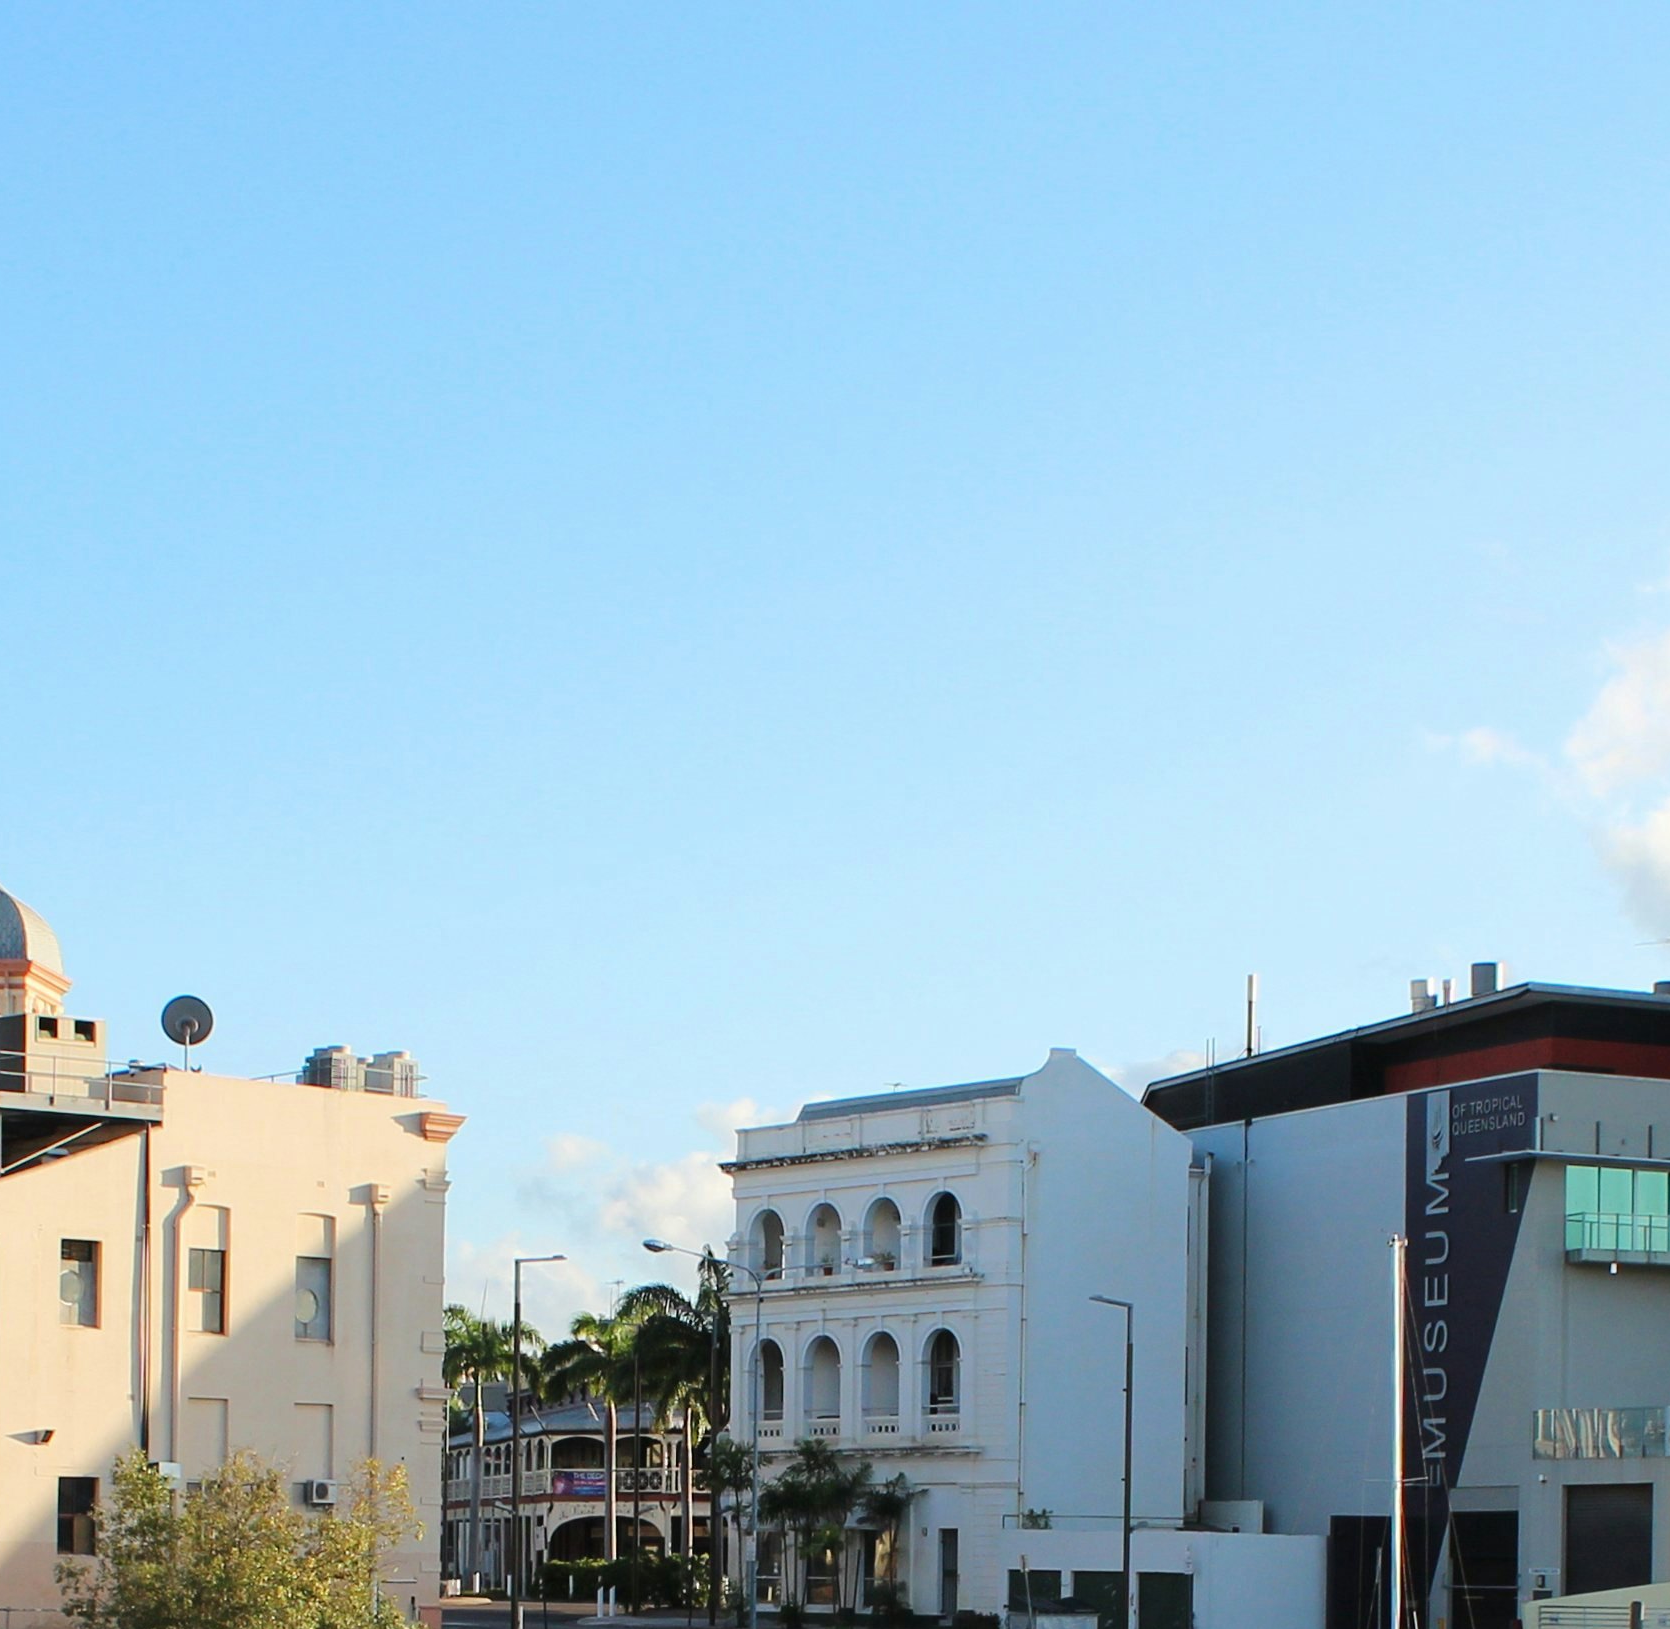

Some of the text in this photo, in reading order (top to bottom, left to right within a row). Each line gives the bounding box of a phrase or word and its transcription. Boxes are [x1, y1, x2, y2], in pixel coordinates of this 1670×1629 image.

[1452, 1095, 1523, 1119] OF TROPICAL
[1452, 1112, 1526, 1136] QUEENSLAND
[1423, 1172, 1449, 1458] MUSEUM
